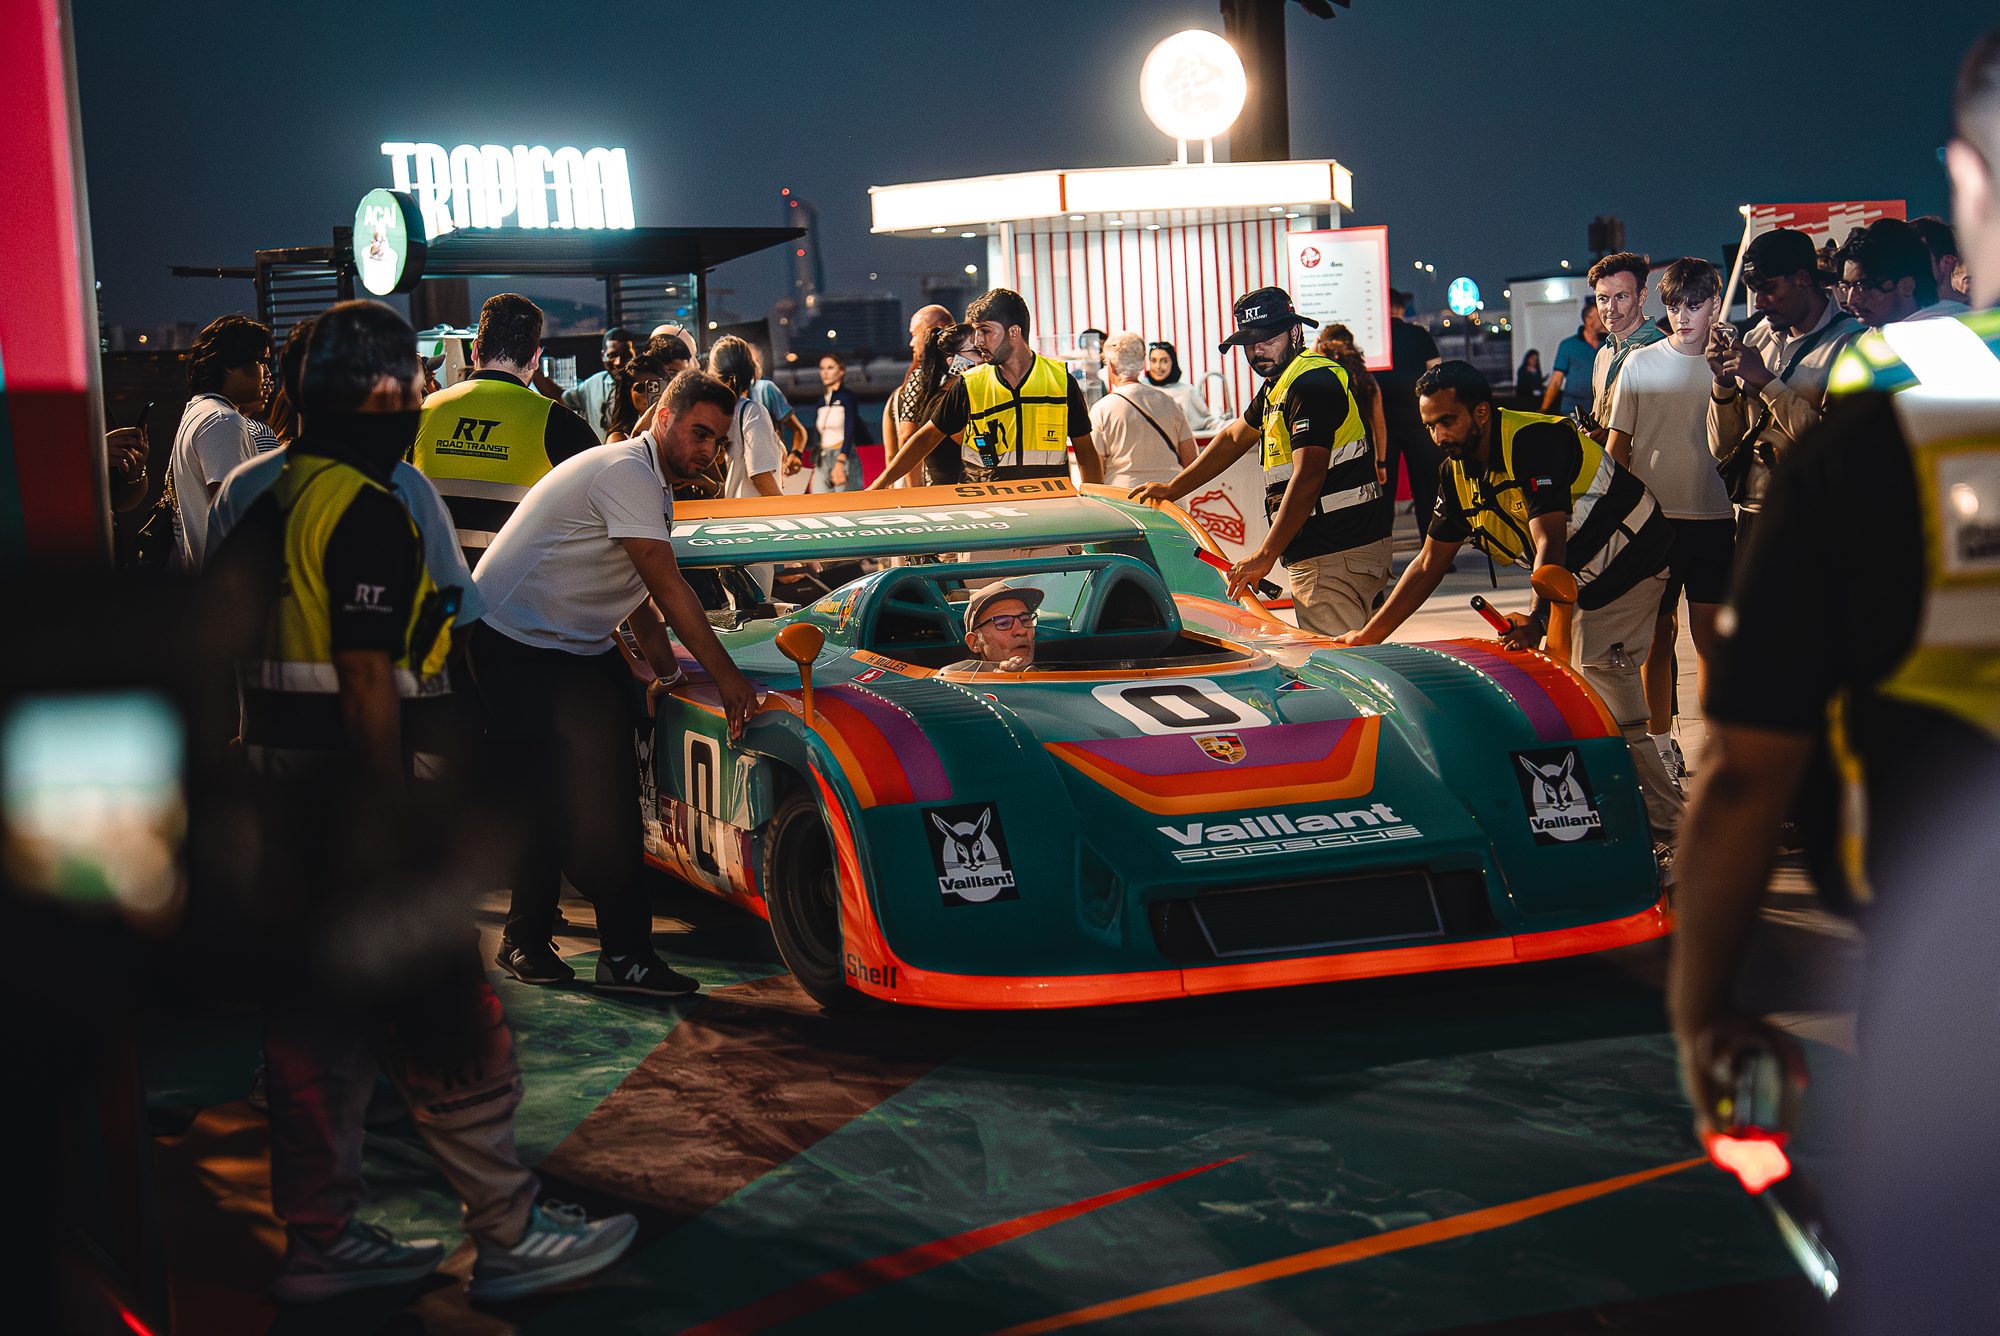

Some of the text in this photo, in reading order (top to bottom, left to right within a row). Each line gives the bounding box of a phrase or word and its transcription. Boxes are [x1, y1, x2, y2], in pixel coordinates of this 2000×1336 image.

[1244, 306, 1261, 318] RT
[452, 417, 502, 443] RT
[436, 440, 510, 453] ROAD TRANSIT
[955, 480, 1066, 497] Shell
[688, 521, 1010, 546] Gas-Zentralheizung
[355, 583, 386, 604] RT
[1120, 685, 1241, 728] 0
[1157, 803, 1402, 845] Vaillant
[1532, 812, 1600, 830] Vaillant
[1172, 826, 1422, 862] PORSCHE
[940, 872, 1014, 891] Vaillant
[847, 953, 897, 988] Shell
